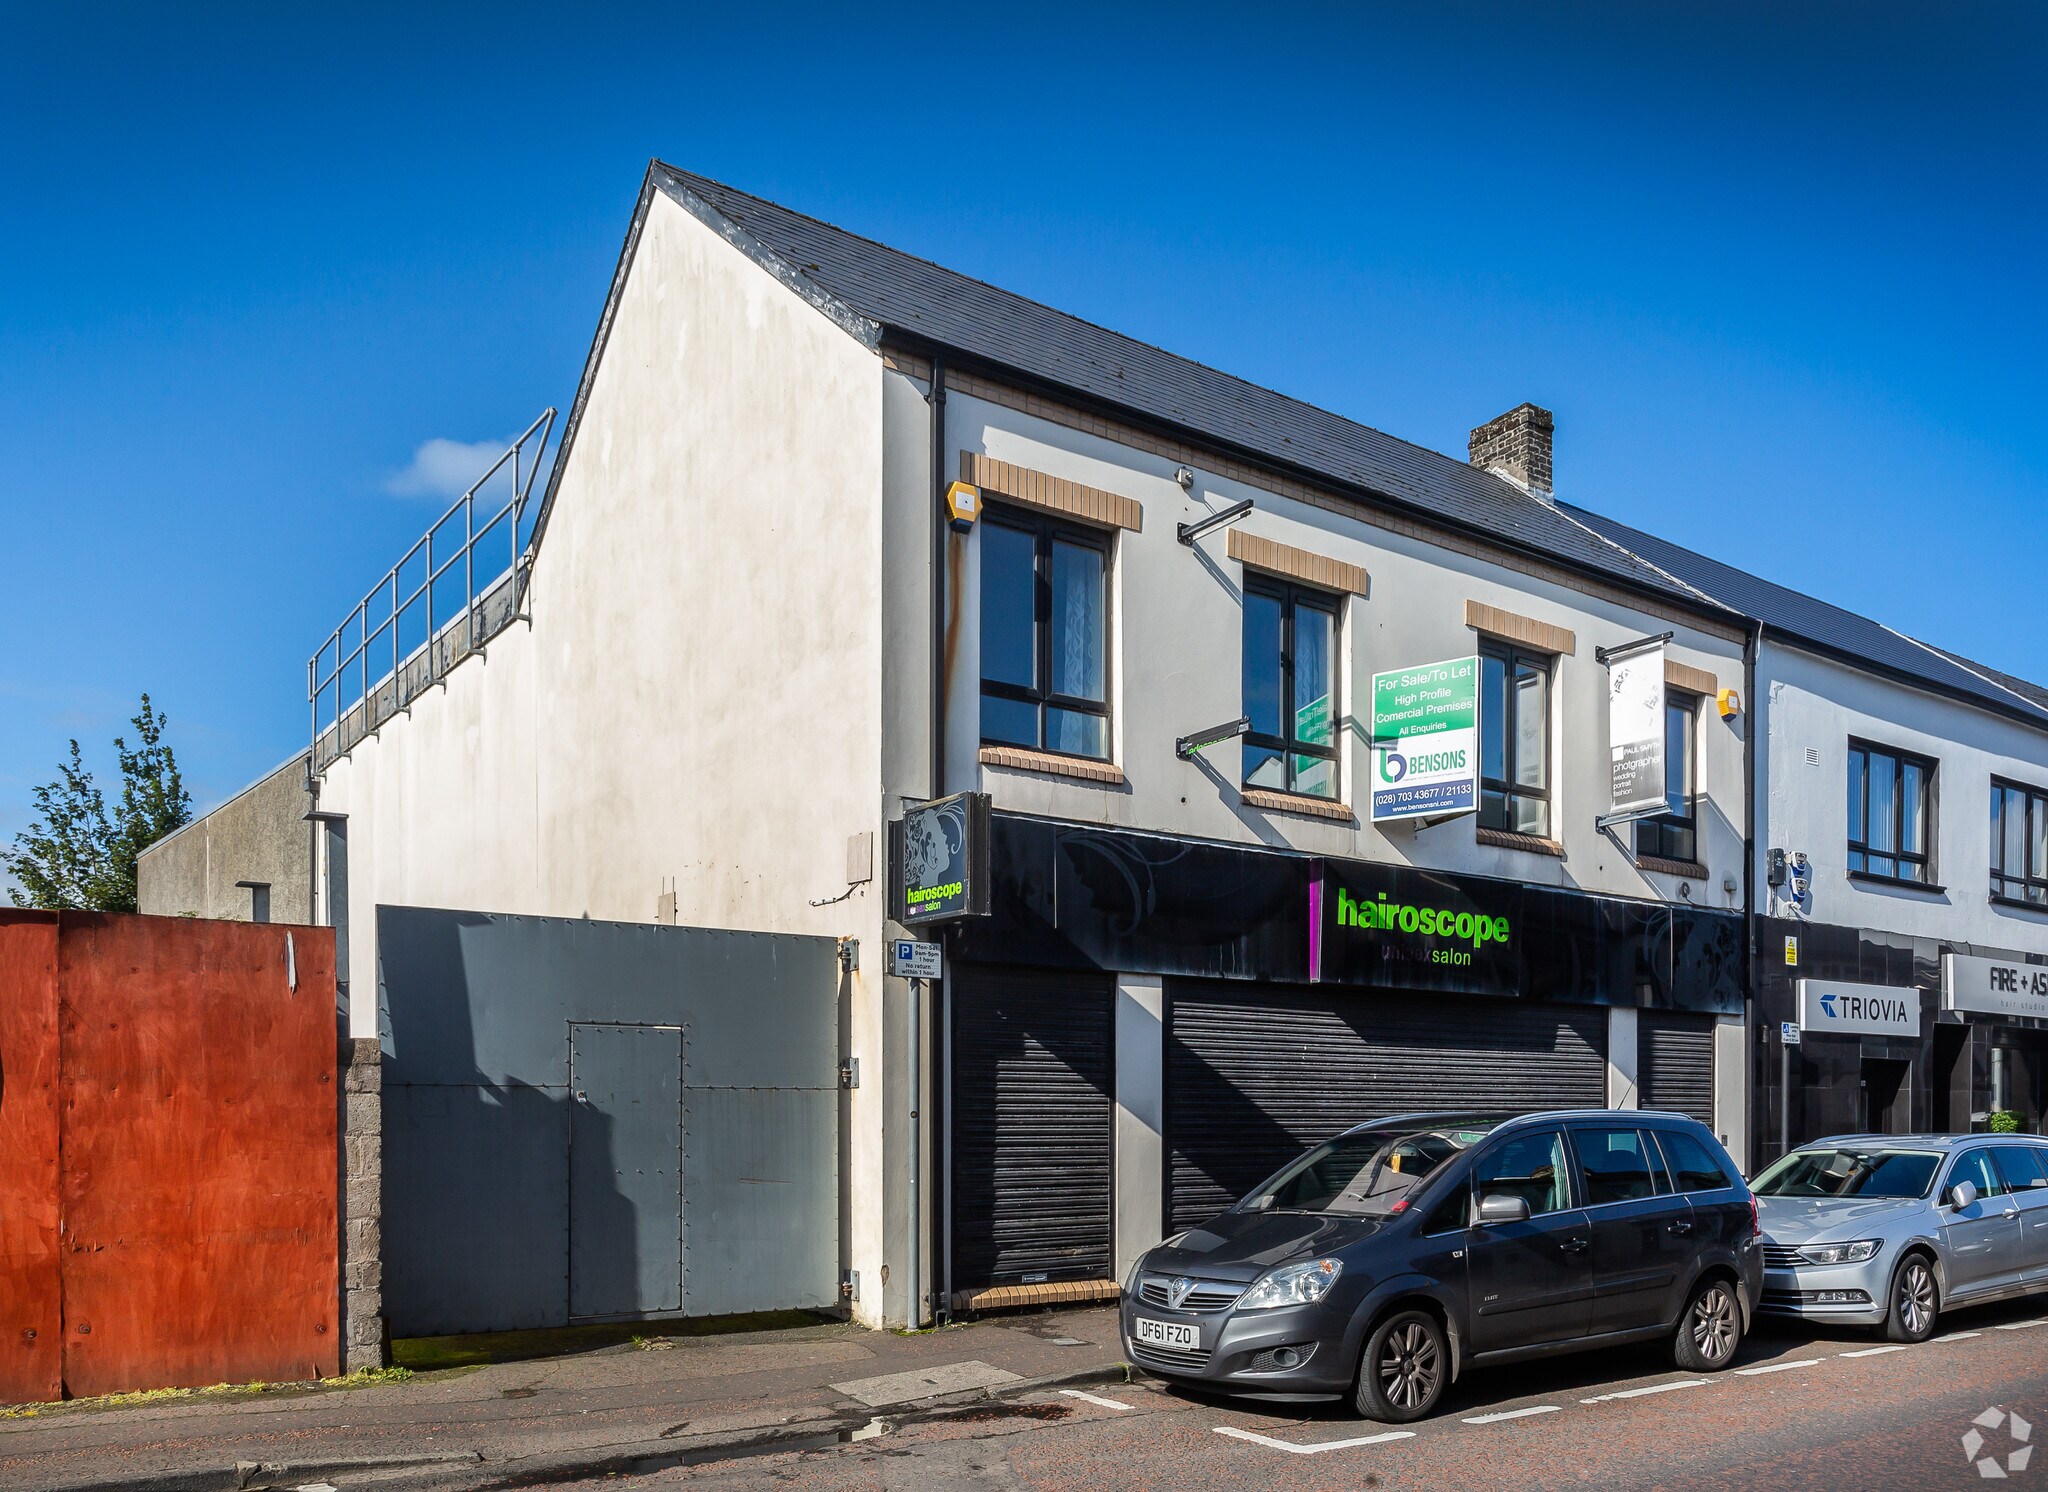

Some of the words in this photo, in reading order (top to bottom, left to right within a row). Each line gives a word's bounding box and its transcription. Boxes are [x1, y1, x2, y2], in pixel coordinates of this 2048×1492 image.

[1378, 679, 1398, 692] For
[1400, 669, 1448, 687] Sale/To
[1451, 664, 1471, 679] Let
[1394, 693, 1417, 706] High
[1420, 688, 1452, 701] Profile
[1376, 706, 1424, 724] Comercial
[1426, 700, 1473, 715] Premises
[1398, 727, 1409, 735] All
[1410, 722, 1447, 734] Enquiries
[1409, 750, 1466, 774] BENSONS
[1613, 771, 1636, 781] wedding
[1613, 780, 1631, 790] portrait
[1375, 794, 1396, 806] (028)
[1398, 791, 1413, 802] 703
[1414, 788, 1440, 800] 43677
[1446, 784, 1471, 796] 21133
[1613, 788, 1633, 797] fashion
[1392, 800, 1453, 812] www.bensonsni.com
[907, 881, 962, 904] hairoscope
[1337, 888, 1510, 948] hairoscope
[901, 945, 910, 958] P
[1432, 948, 1471, 965] salon
[1990, 966, 2018, 993] FIRE
[2030, 972, 2048, 997] AS
[1840, 996, 1908, 1022] TRIOVIA
[2021, 1002, 2045, 1011] studio
[1142, 1321, 1164, 1340] DF61
[1167, 1326, 1191, 1344] FZO
